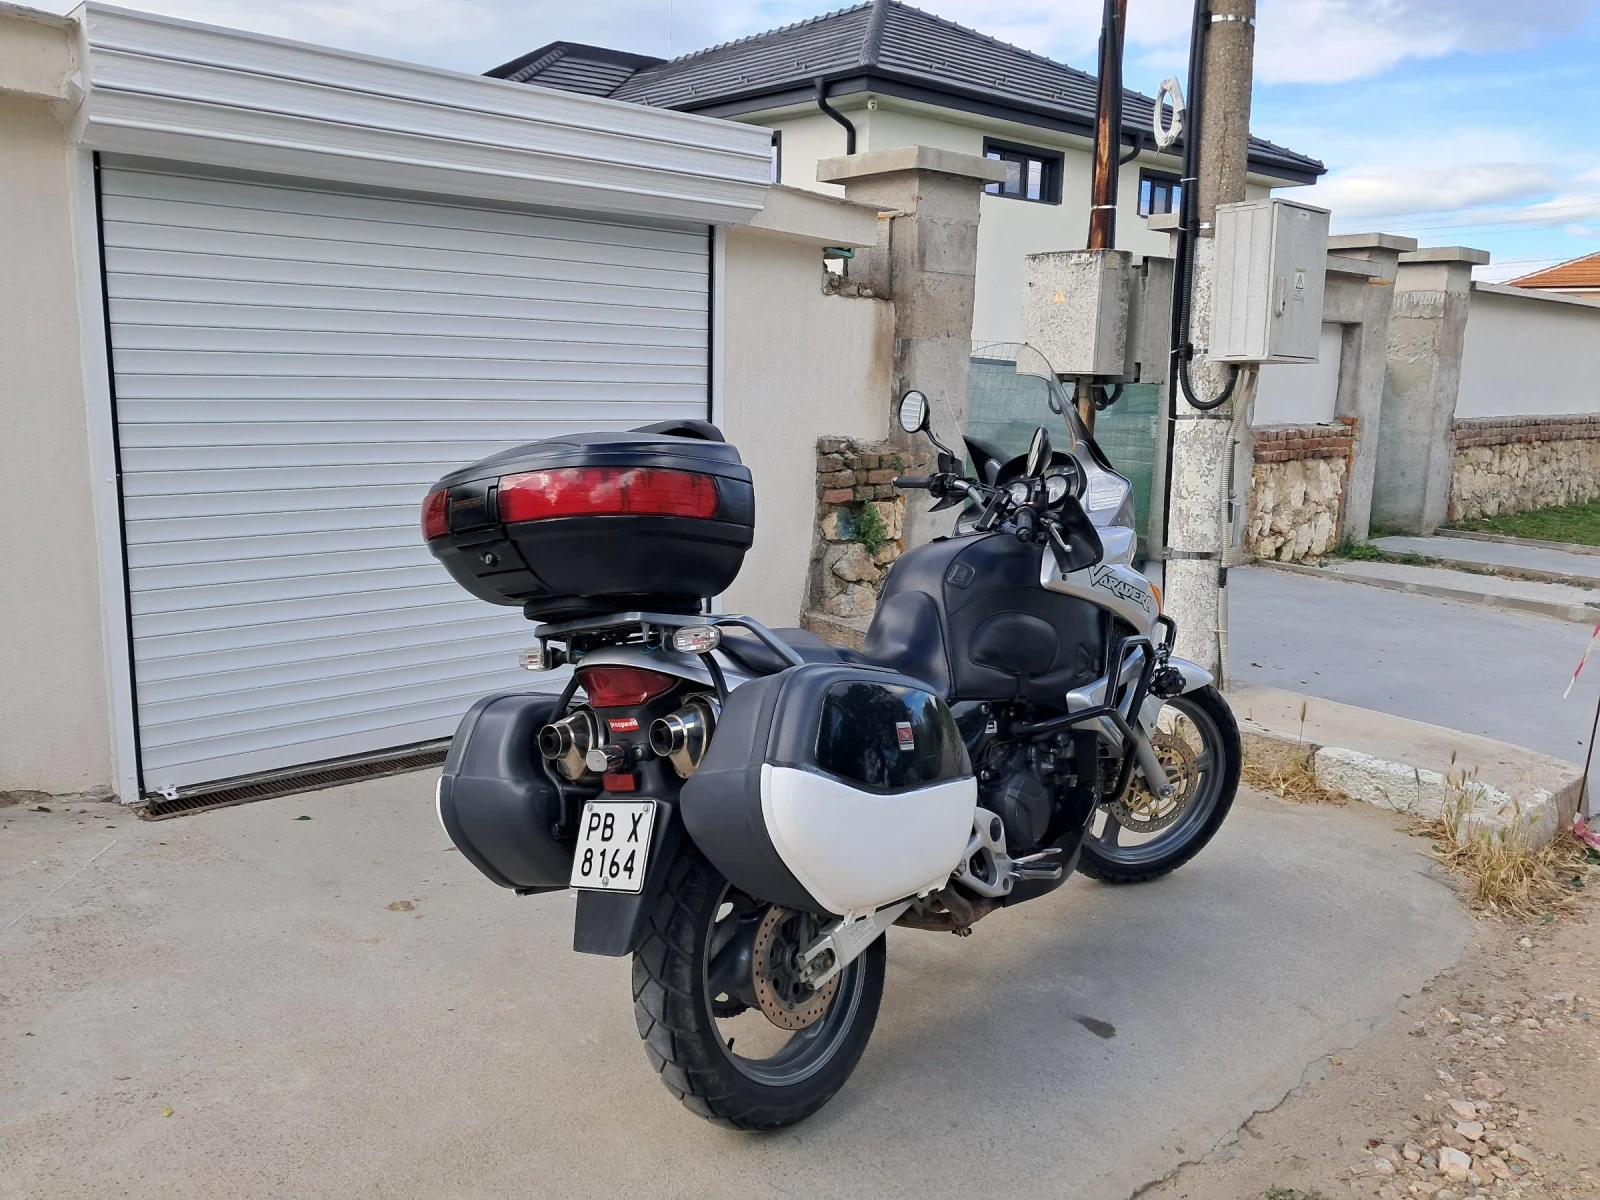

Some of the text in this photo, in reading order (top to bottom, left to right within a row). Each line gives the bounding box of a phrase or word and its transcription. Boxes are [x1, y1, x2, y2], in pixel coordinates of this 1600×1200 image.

[586, 813, 643, 843] PB X
[581, 848, 636, 880] 8164
